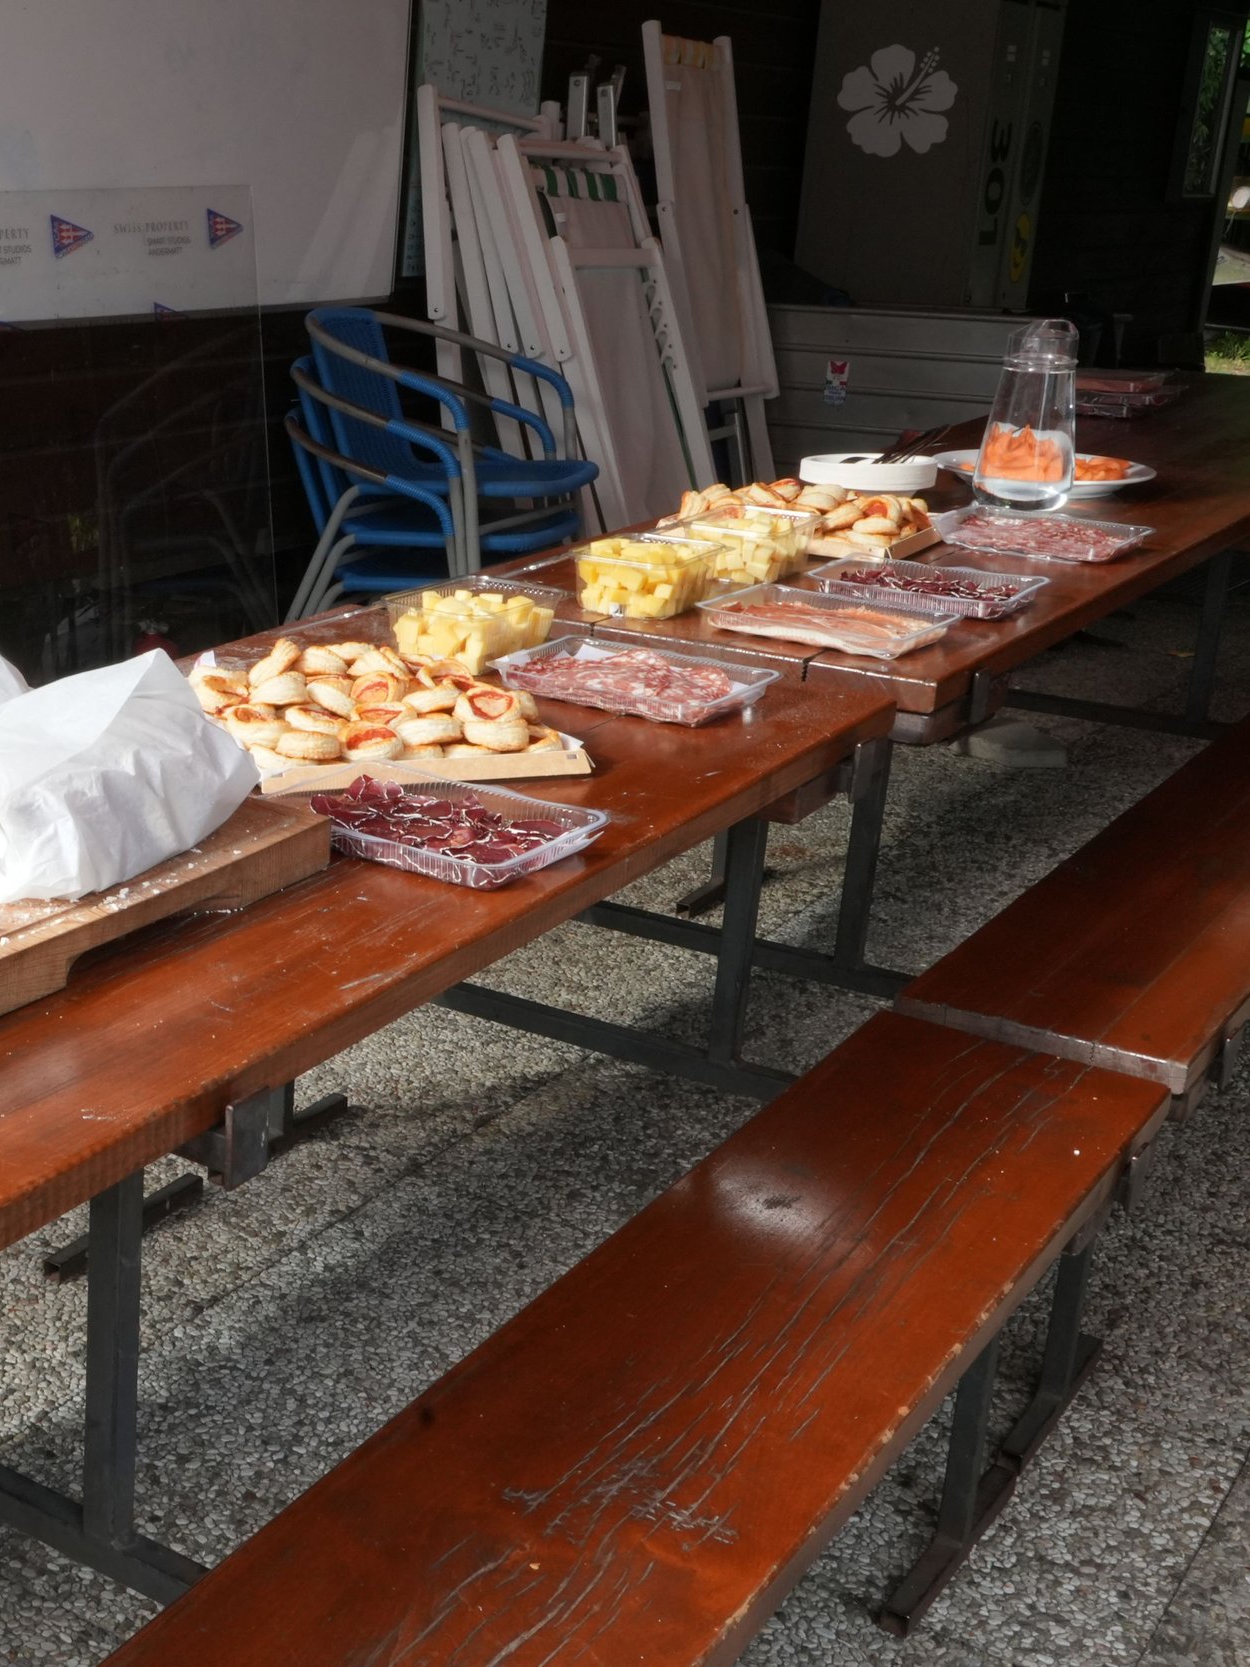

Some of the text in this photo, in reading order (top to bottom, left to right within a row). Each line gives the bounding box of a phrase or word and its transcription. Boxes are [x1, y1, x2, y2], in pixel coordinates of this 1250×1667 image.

[113, 220, 189, 234] SWISS PROPERTY
[3, 244, 32, 254] STUDIOS
